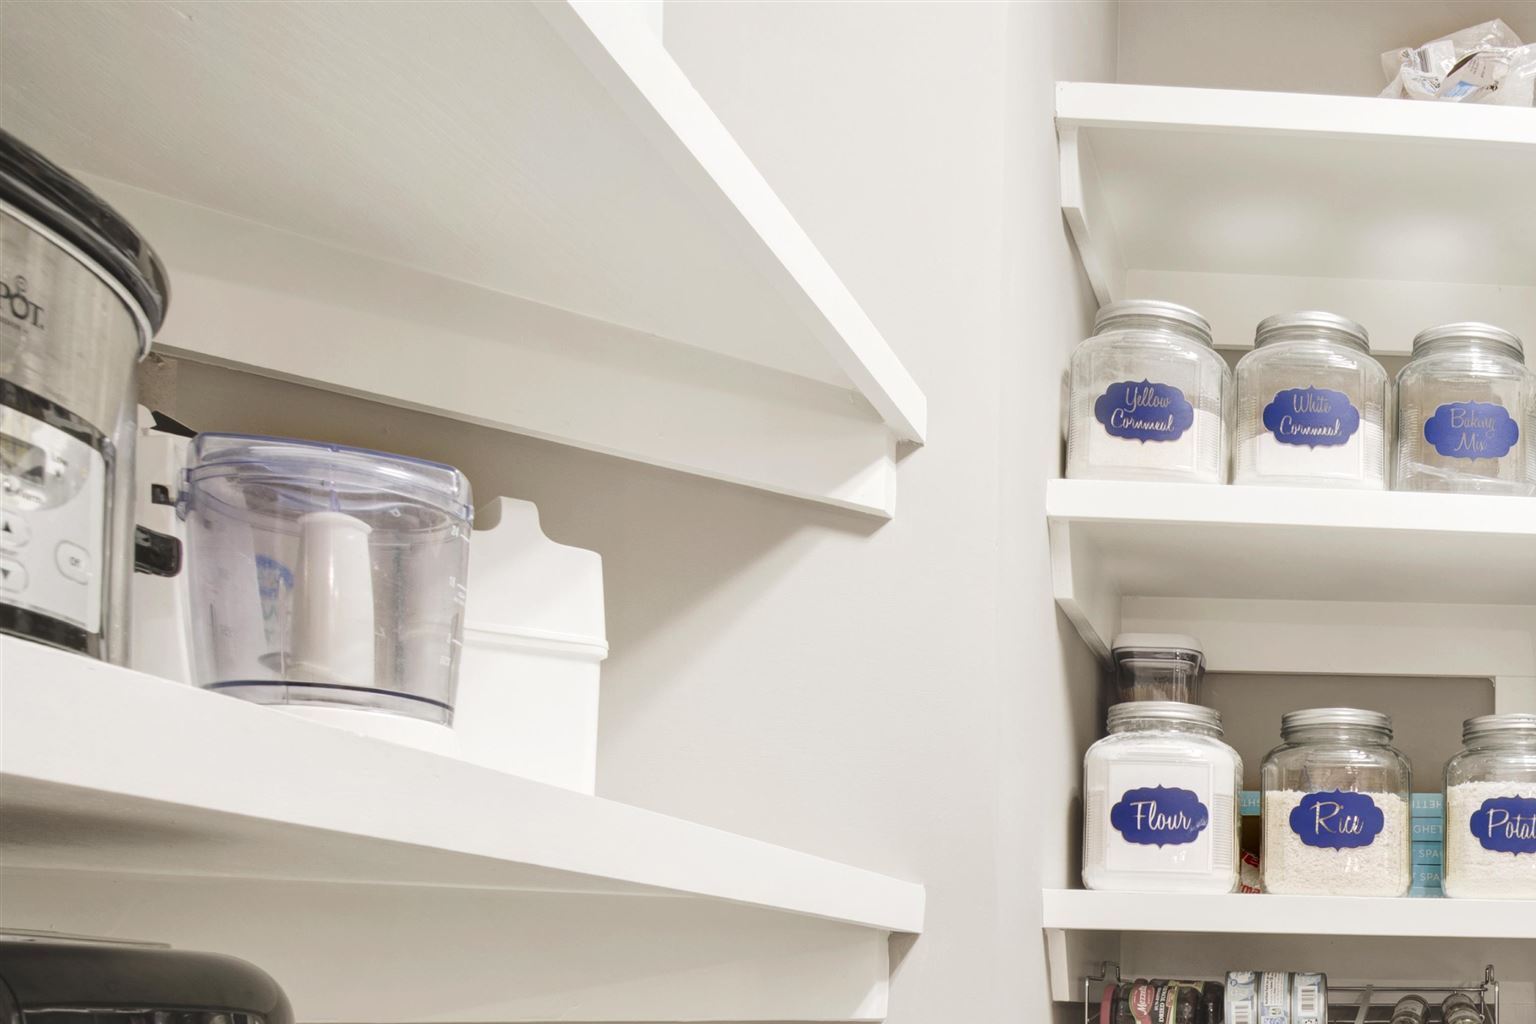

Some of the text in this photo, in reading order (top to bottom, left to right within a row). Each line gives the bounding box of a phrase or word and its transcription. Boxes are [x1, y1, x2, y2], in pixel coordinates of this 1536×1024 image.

[1124, 387, 1170, 413] Yellow
[1292, 393, 1332, 415] White
[1110, 408, 1175, 432] Cornmeal
[1279, 415, 1342, 437] Cornmeal
[1450, 408, 1496, 436] Baking
[1453, 433, 1488, 451] Mix
[1129, 801, 1192, 832] Flour
[1309, 801, 1364, 835] Rice
